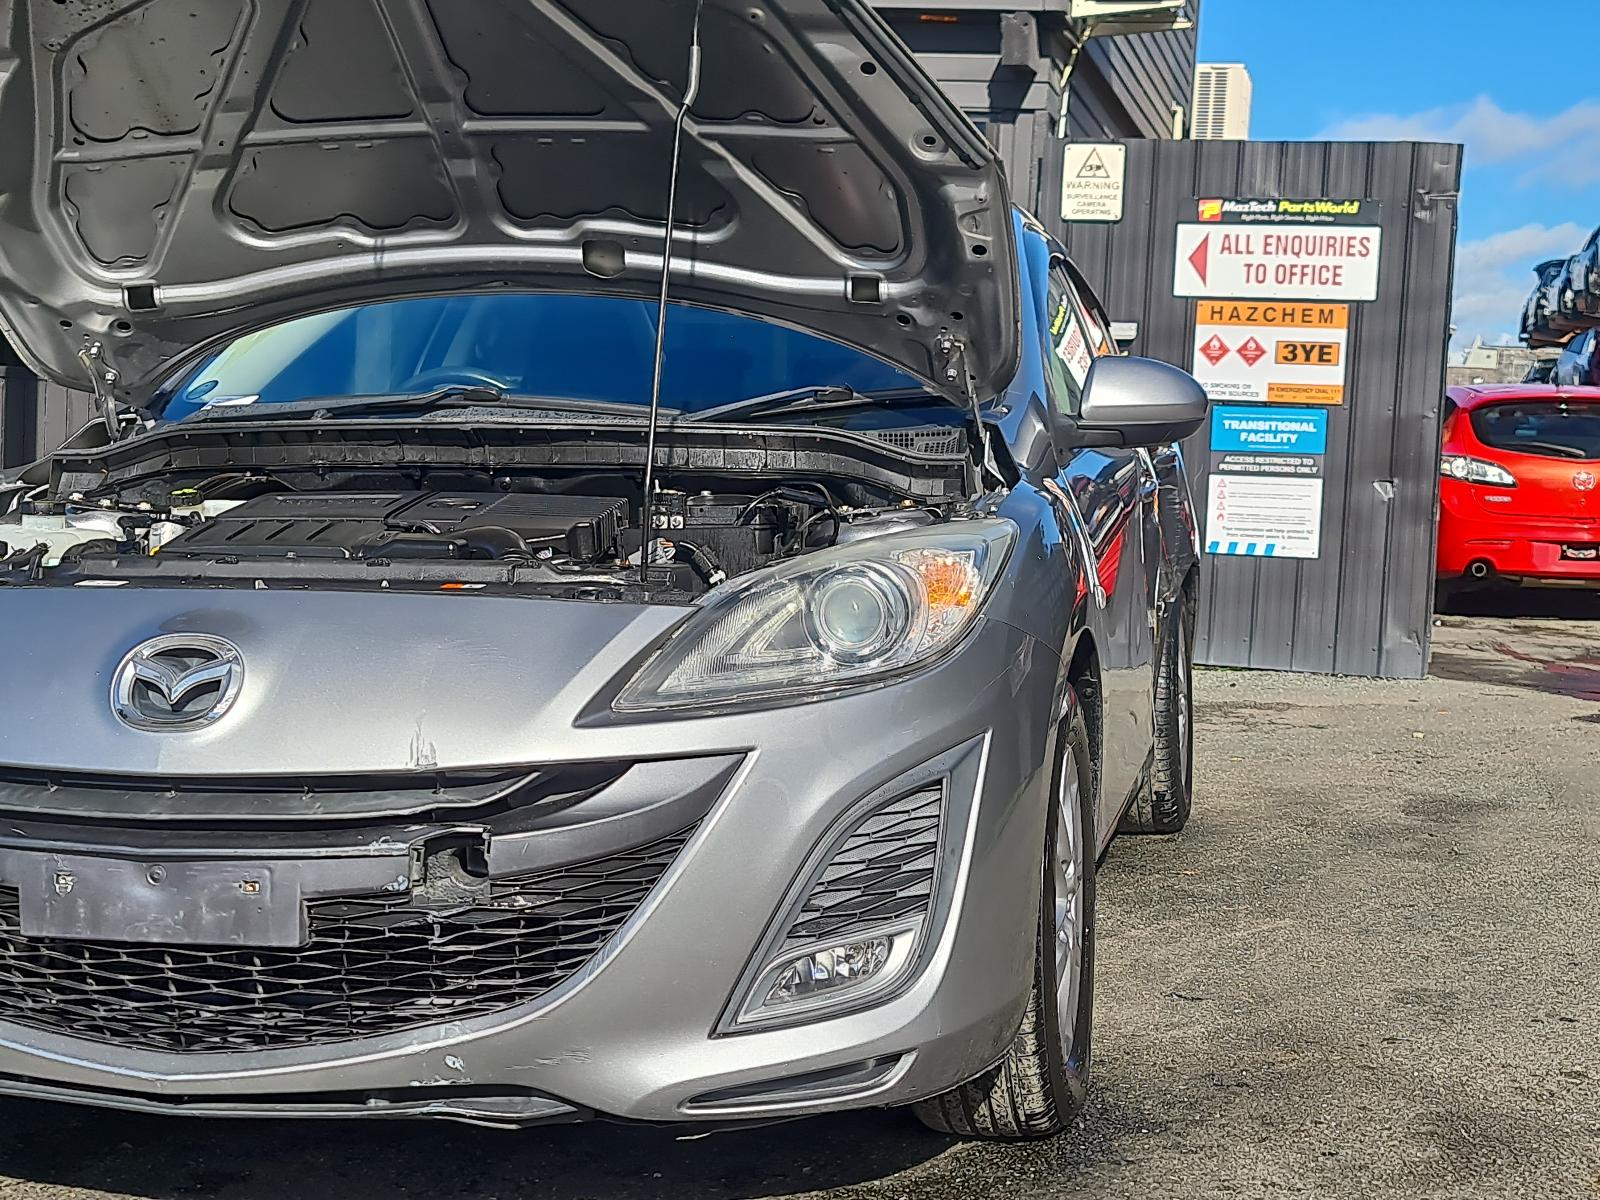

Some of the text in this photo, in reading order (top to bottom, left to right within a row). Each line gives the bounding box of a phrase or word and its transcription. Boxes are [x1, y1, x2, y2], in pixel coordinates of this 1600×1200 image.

[1066, 181, 1120, 190] WARNING
[1278, 200, 1360, 214] PartsWorld
[1220, 234, 1371, 258] ALL ENQUIRIES
[1244, 263, 1343, 286] TO OFFICE
[1210, 306, 1334, 324] HAZCHEM
[1282, 343, 1333, 362] 3YE
[1222, 419, 1318, 432] TRANSITIONAL
[1240, 432, 1299, 444] FACILITY
[1255, 456, 1302, 465] RESTRICTED
[1218, 463, 1259, 471] PERMITTED
[1260, 464, 1295, 473] PERSONS
